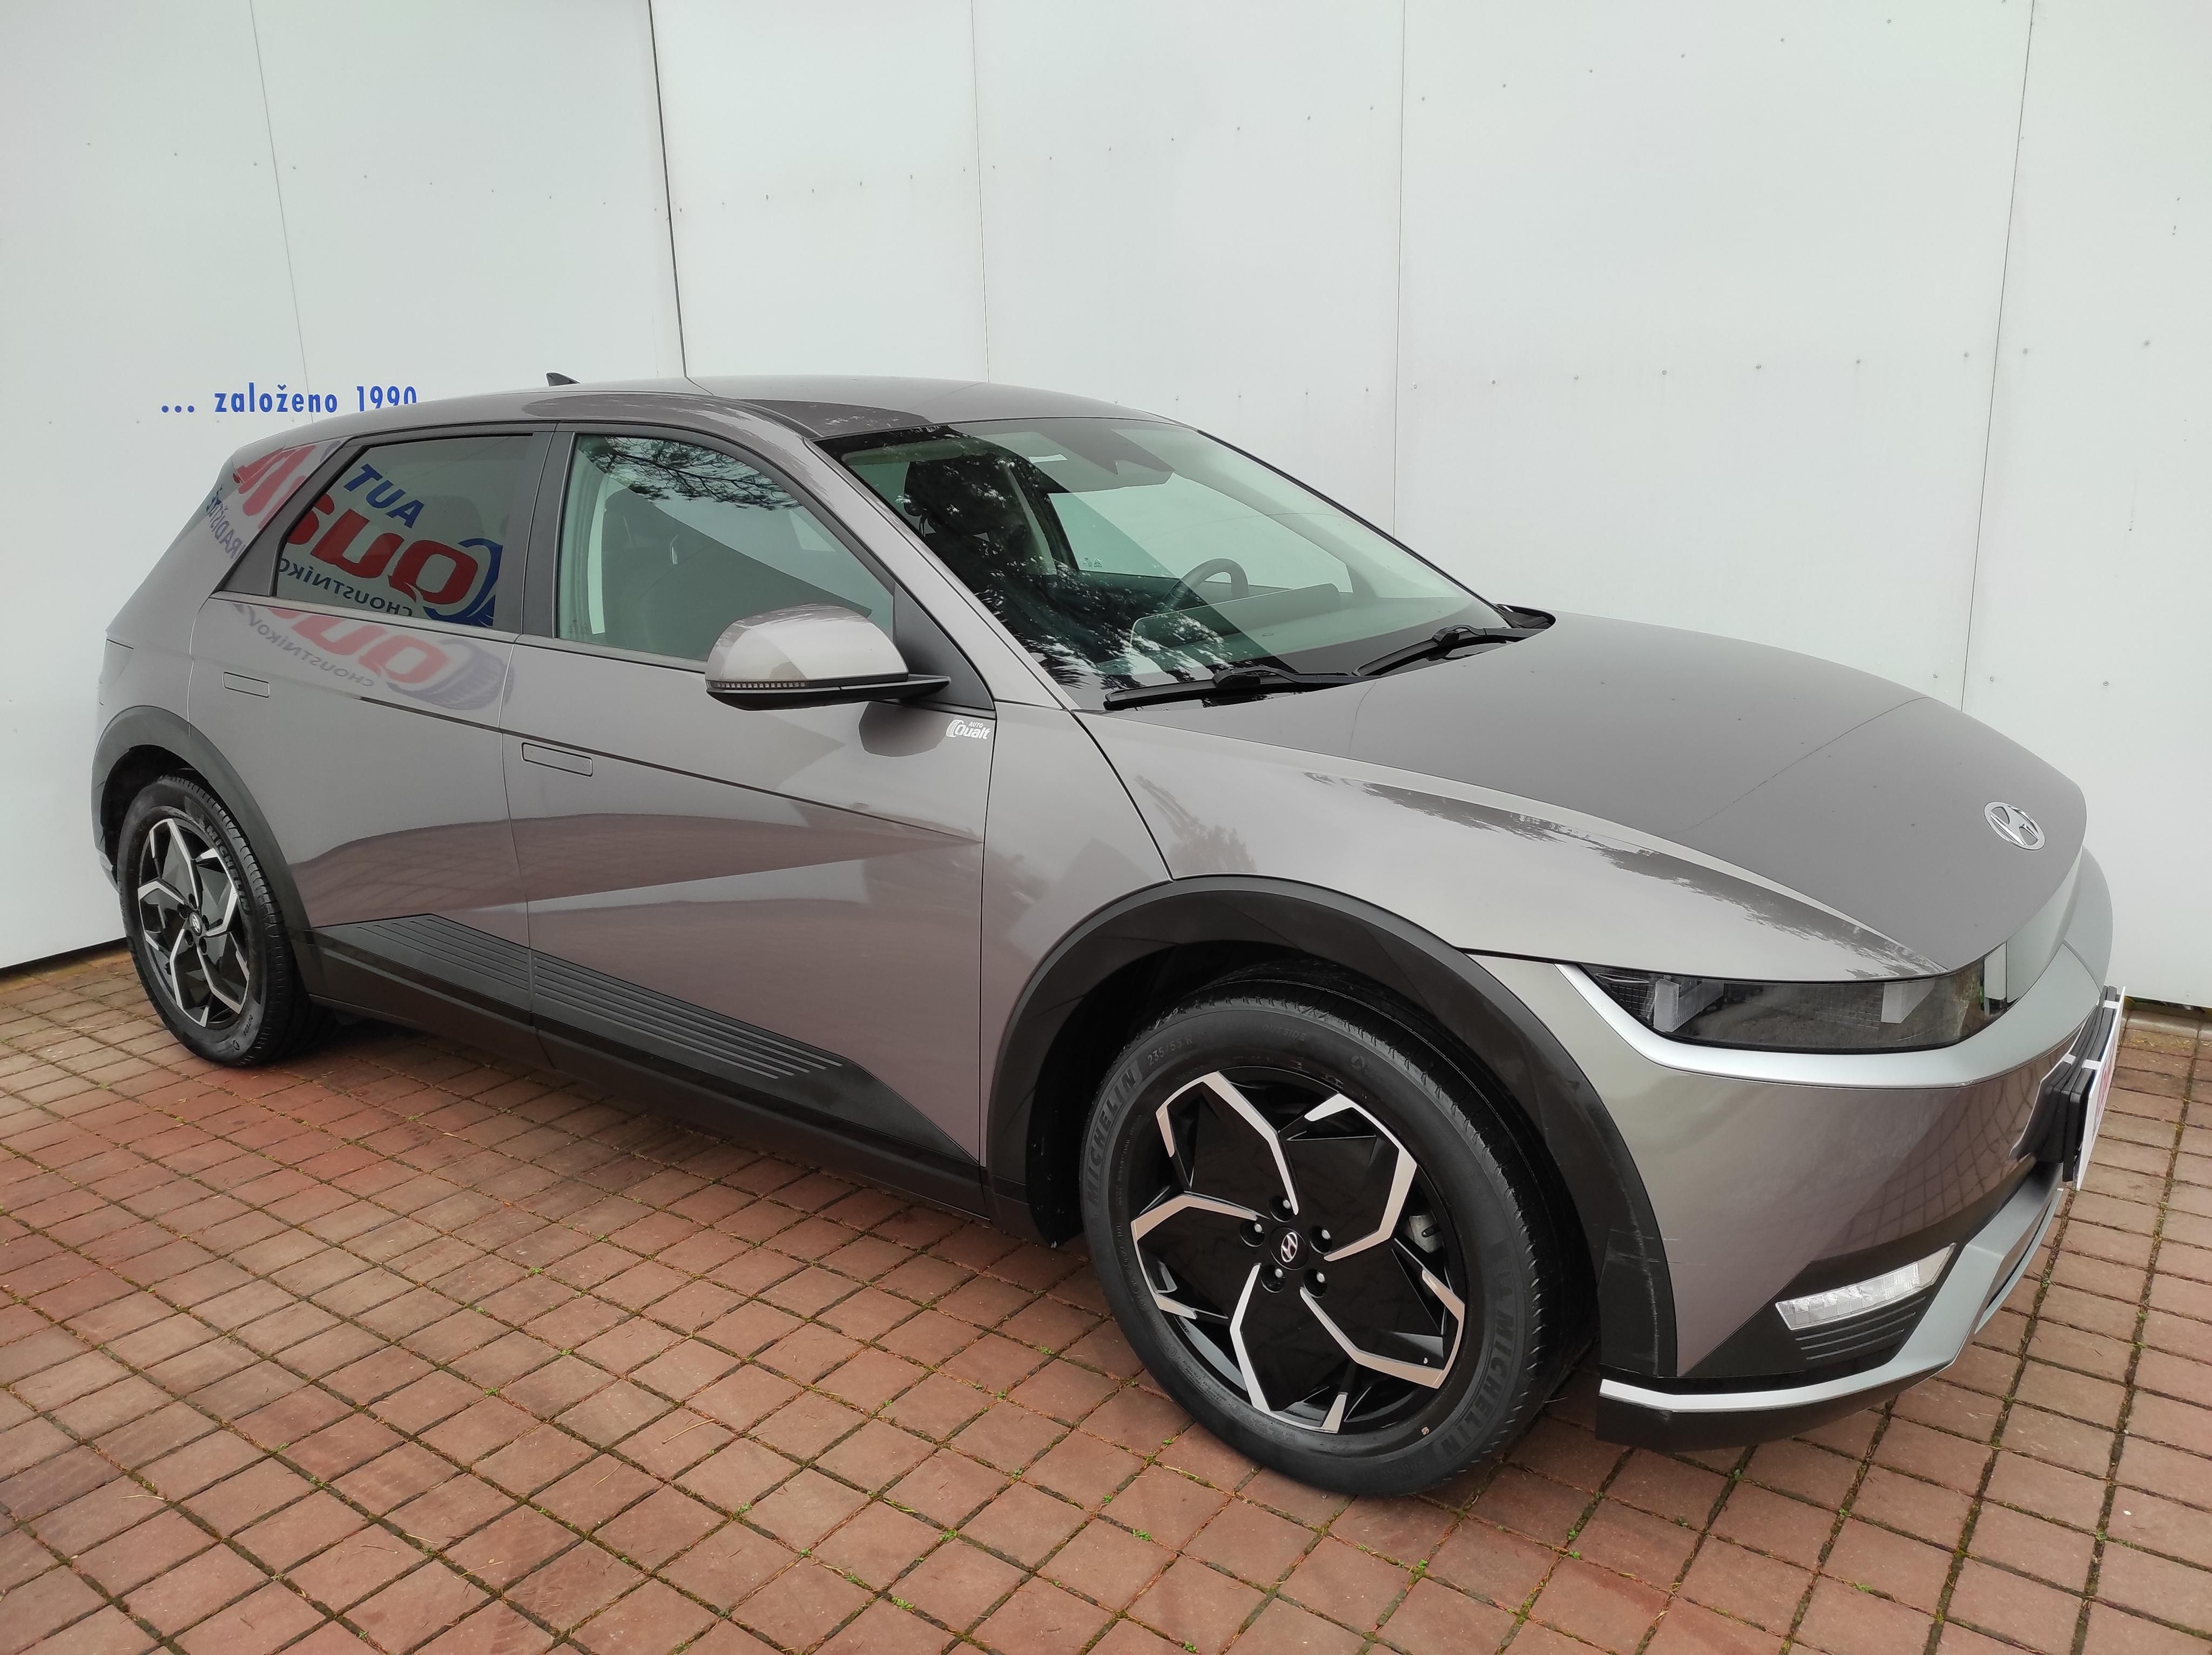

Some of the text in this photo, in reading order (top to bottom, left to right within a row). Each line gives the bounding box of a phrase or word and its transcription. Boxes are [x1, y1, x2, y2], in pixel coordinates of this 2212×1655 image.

[214, 382, 338, 413] založeno
[356, 386, 417, 412] 1990
[1263, 1024, 1307, 1042] OUTSIDE
[1087, 1067, 1138, 1207] MICHELIN
[1441, 1309, 1516, 1457] MICHELIN
